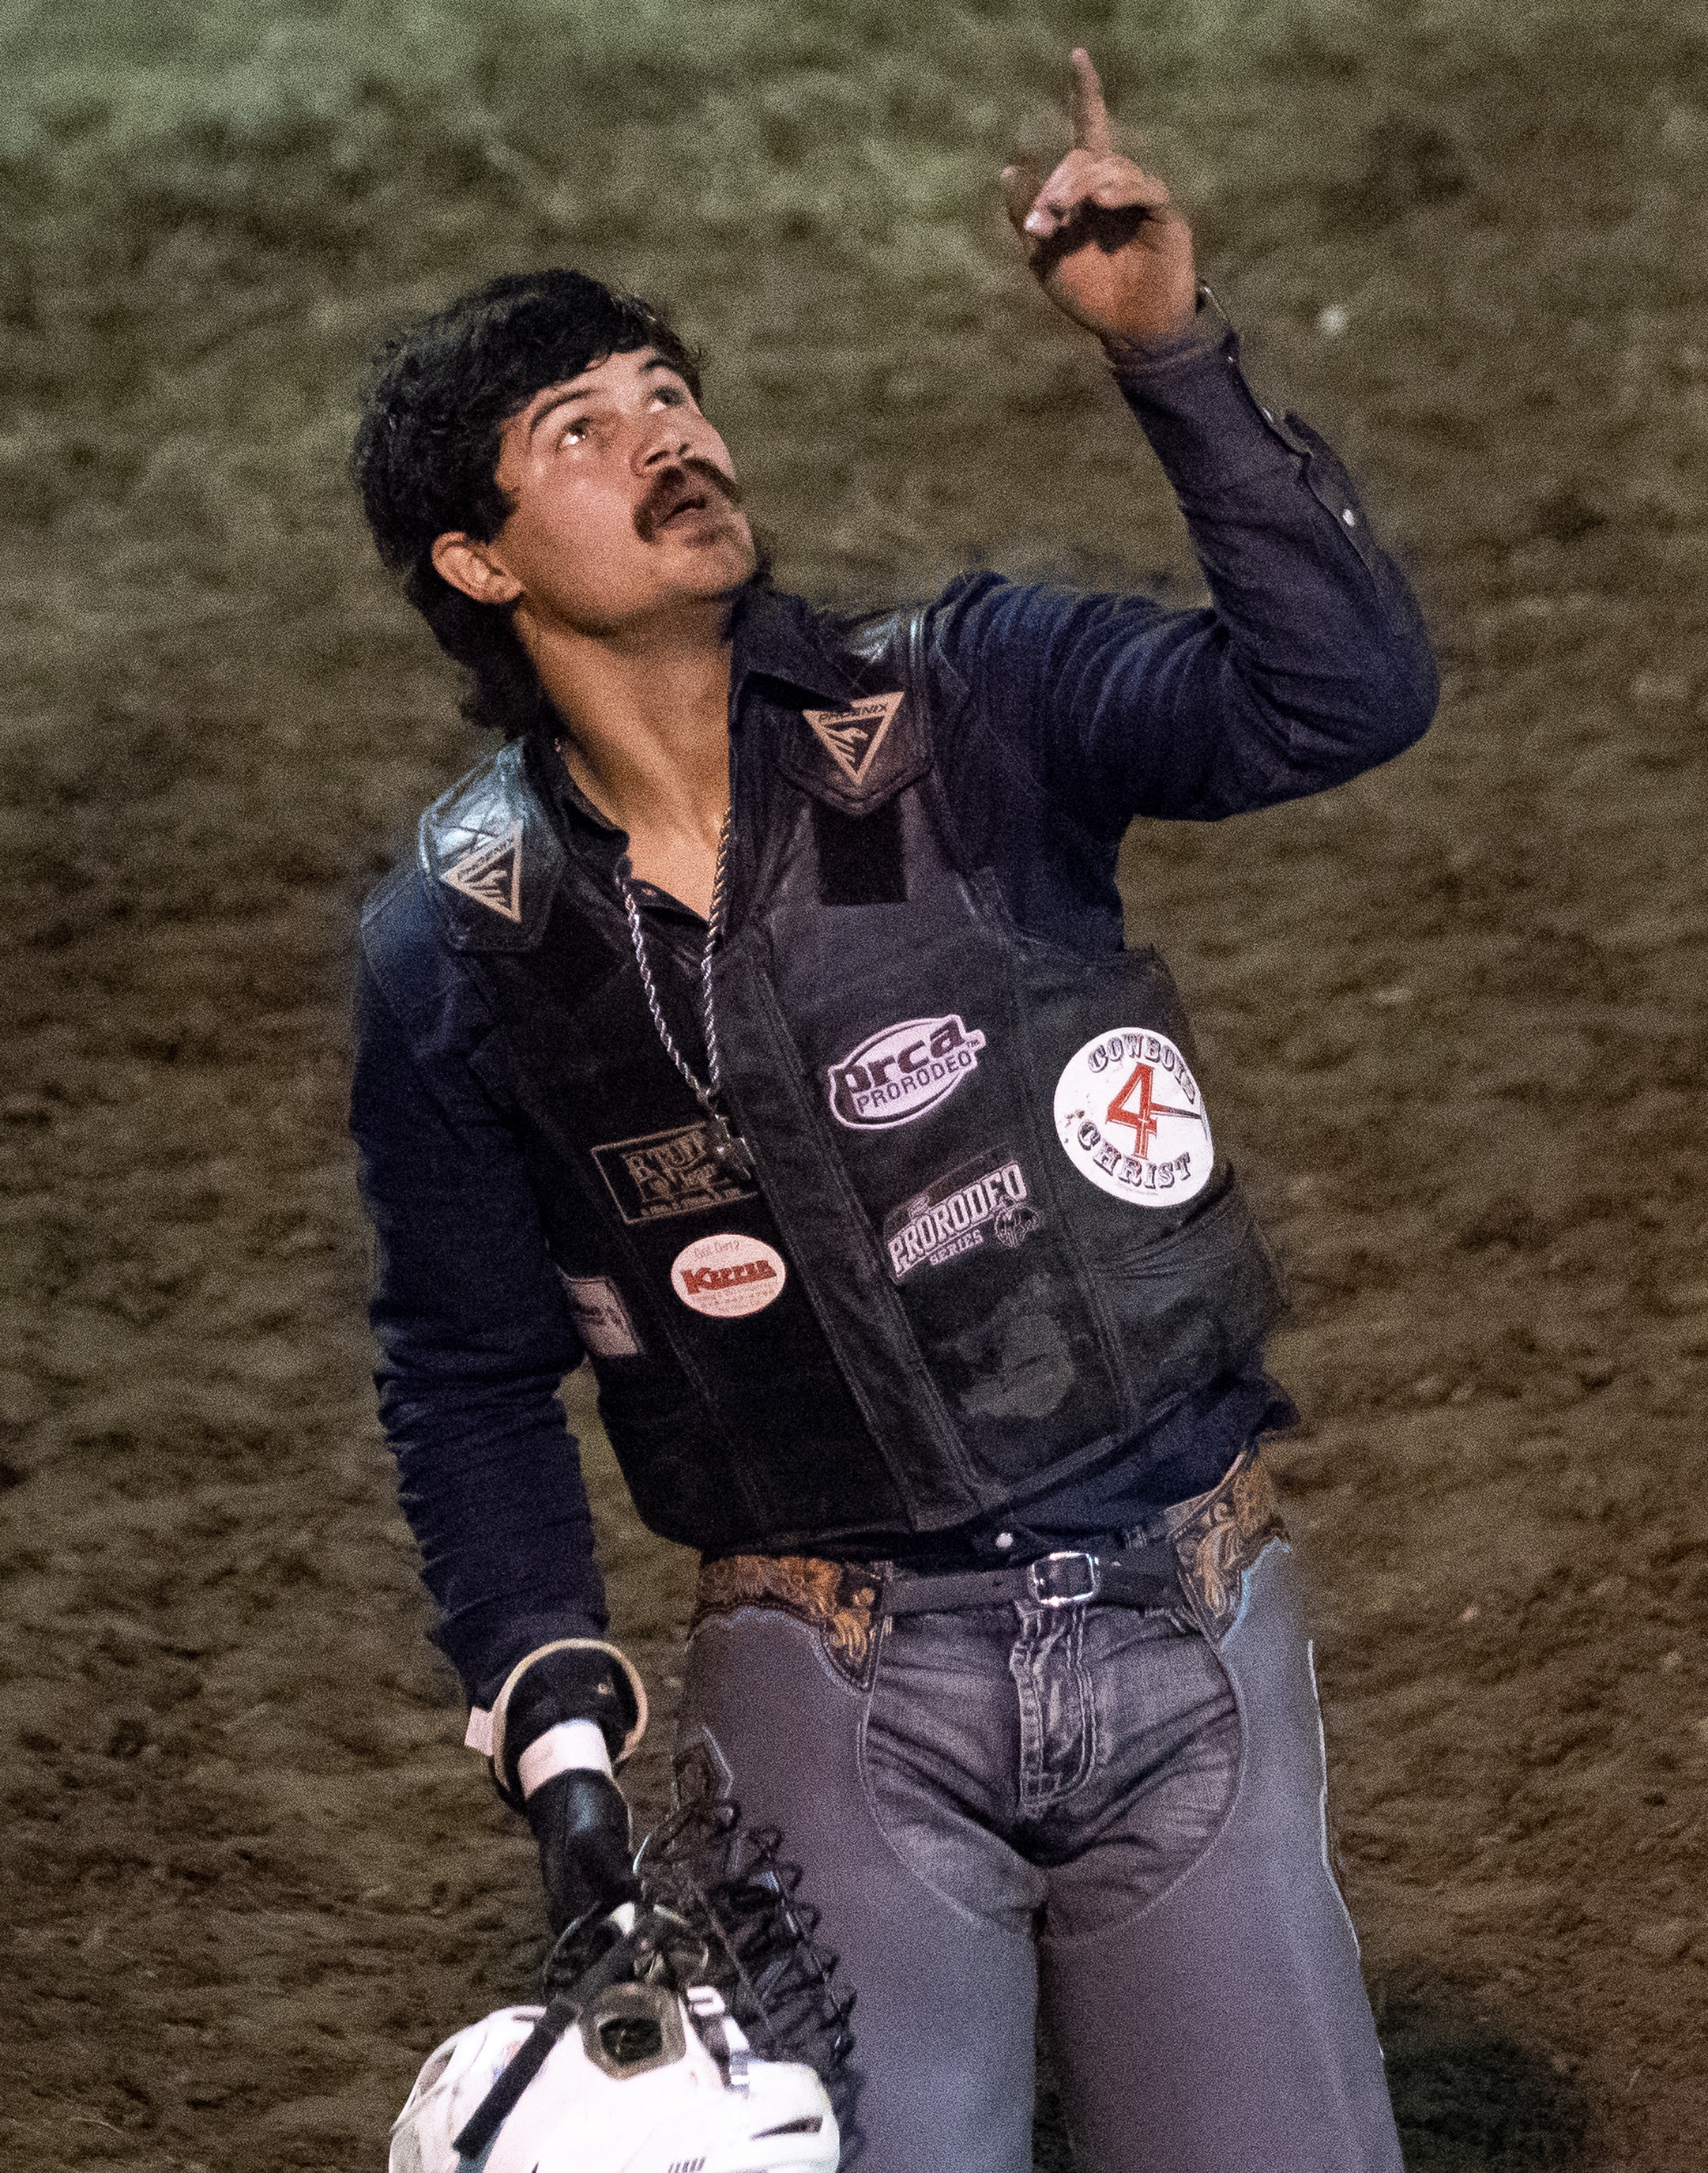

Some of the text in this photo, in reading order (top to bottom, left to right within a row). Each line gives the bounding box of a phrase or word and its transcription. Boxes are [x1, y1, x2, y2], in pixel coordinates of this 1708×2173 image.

[856, 1050, 972, 1114] PRORODEO
[1105, 1062, 1158, 1160] 4
[1078, 1120, 1191, 1189] CHRIST
[888, 1164, 1027, 1274] PRORODEO
[929, 1230, 984, 1265] SERIES
